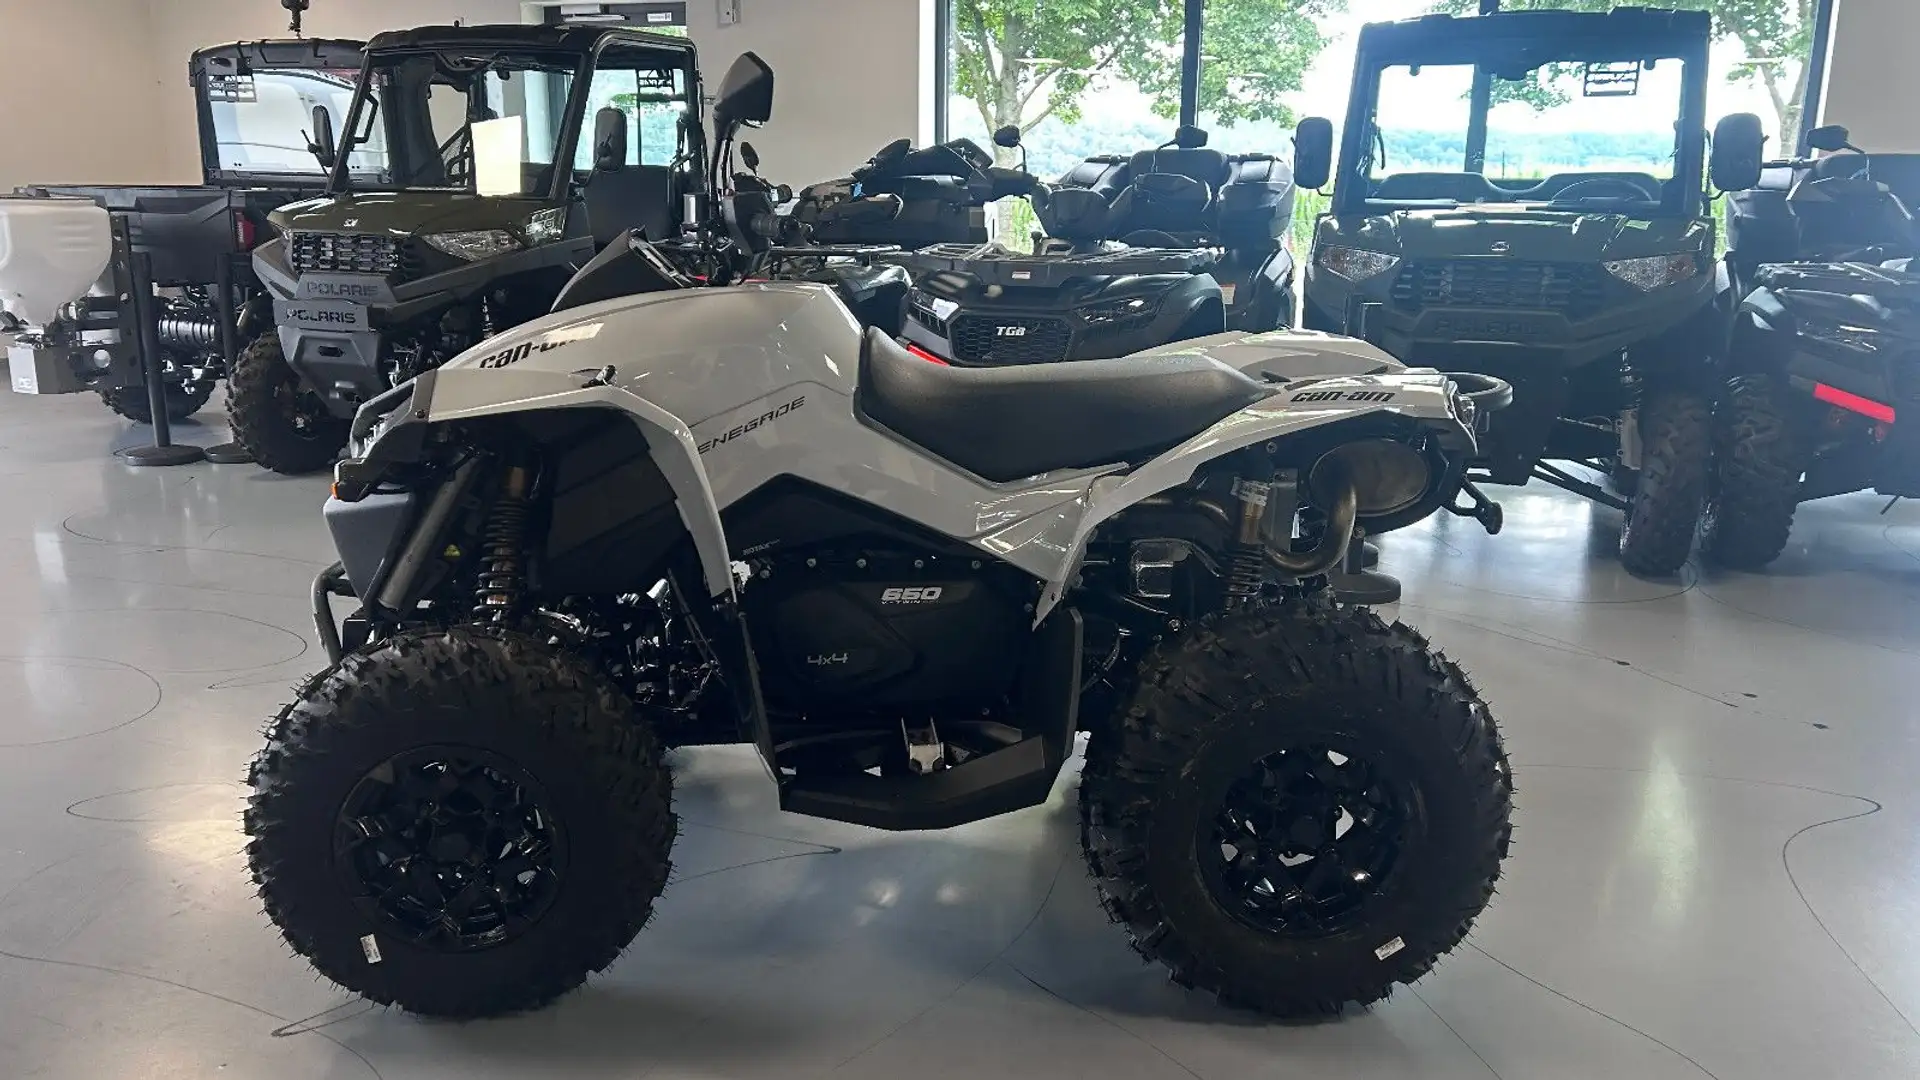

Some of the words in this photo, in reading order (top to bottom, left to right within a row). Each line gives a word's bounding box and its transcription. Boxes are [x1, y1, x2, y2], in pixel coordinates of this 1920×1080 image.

[307, 281, 378, 296] POLARIS
[286, 308, 356, 324] POLARIS
[996, 326, 1026, 336] TGB
[479, 340, 577, 369] can-
[1290, 391, 1396, 402] can-am
[697, 396, 805, 455] ENEGADE
[881, 586, 942, 601] 650
[807, 652, 849, 666] 4x4
